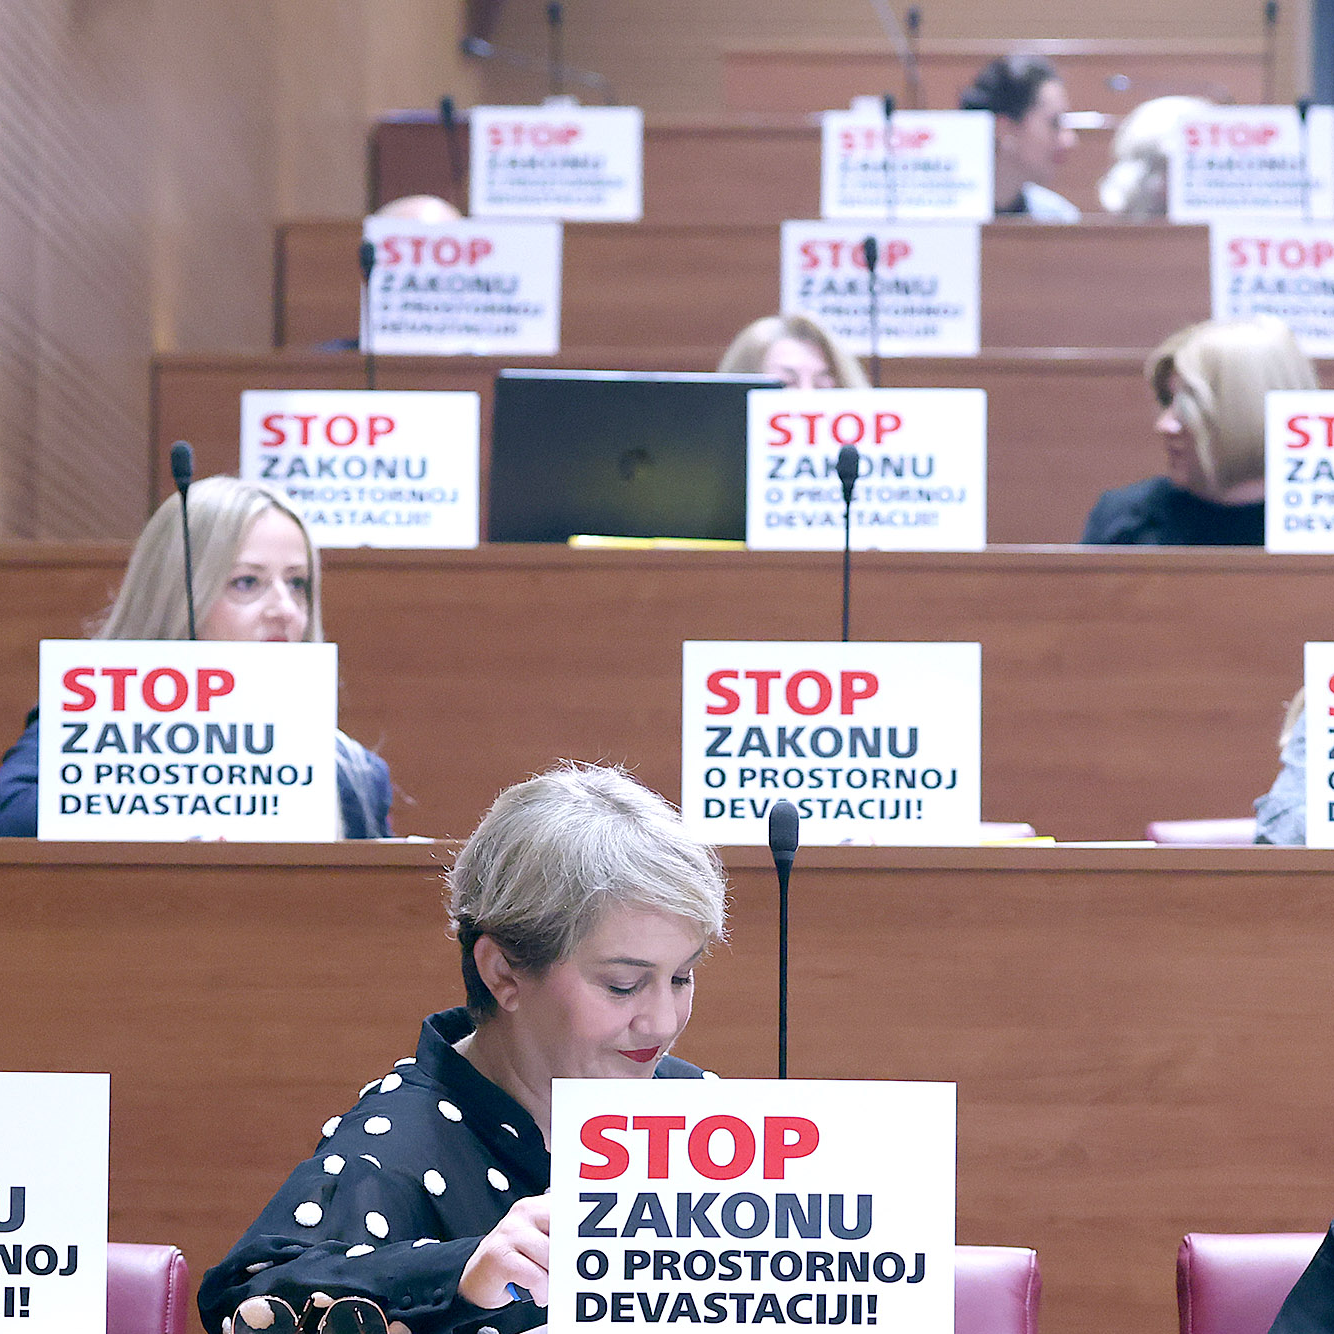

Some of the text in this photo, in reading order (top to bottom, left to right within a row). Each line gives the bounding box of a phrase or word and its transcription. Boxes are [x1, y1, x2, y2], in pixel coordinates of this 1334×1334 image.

[380, 237, 493, 267] STOP
[260, 413, 396, 449] STOP
[768, 413, 903, 447] STOP
[260, 455, 428, 481] ZAKONU
[794, 487, 966, 504] PROTORNOJ
[62, 667, 235, 713] STOP
[706, 669, 879, 716] STOP
[60, 722, 274, 755] ZAKONU
[704, 726, 919, 759] ZAKONU
[60, 763, 313, 786] O PROSTORNOJ
[704, 767, 957, 790] O PROSTORNOJ
[59, 793, 279, 816] DEVASTACIJI!
[704, 797, 924, 820] DEVSTACIJI!
[579, 1115, 819, 1180] STOP
[578, 1192, 872, 1240] ZAKONU
[577, 1250, 925, 1283] O PROSTORNOJ
[576, 1292, 877, 1325] DEVASTACIJI!
